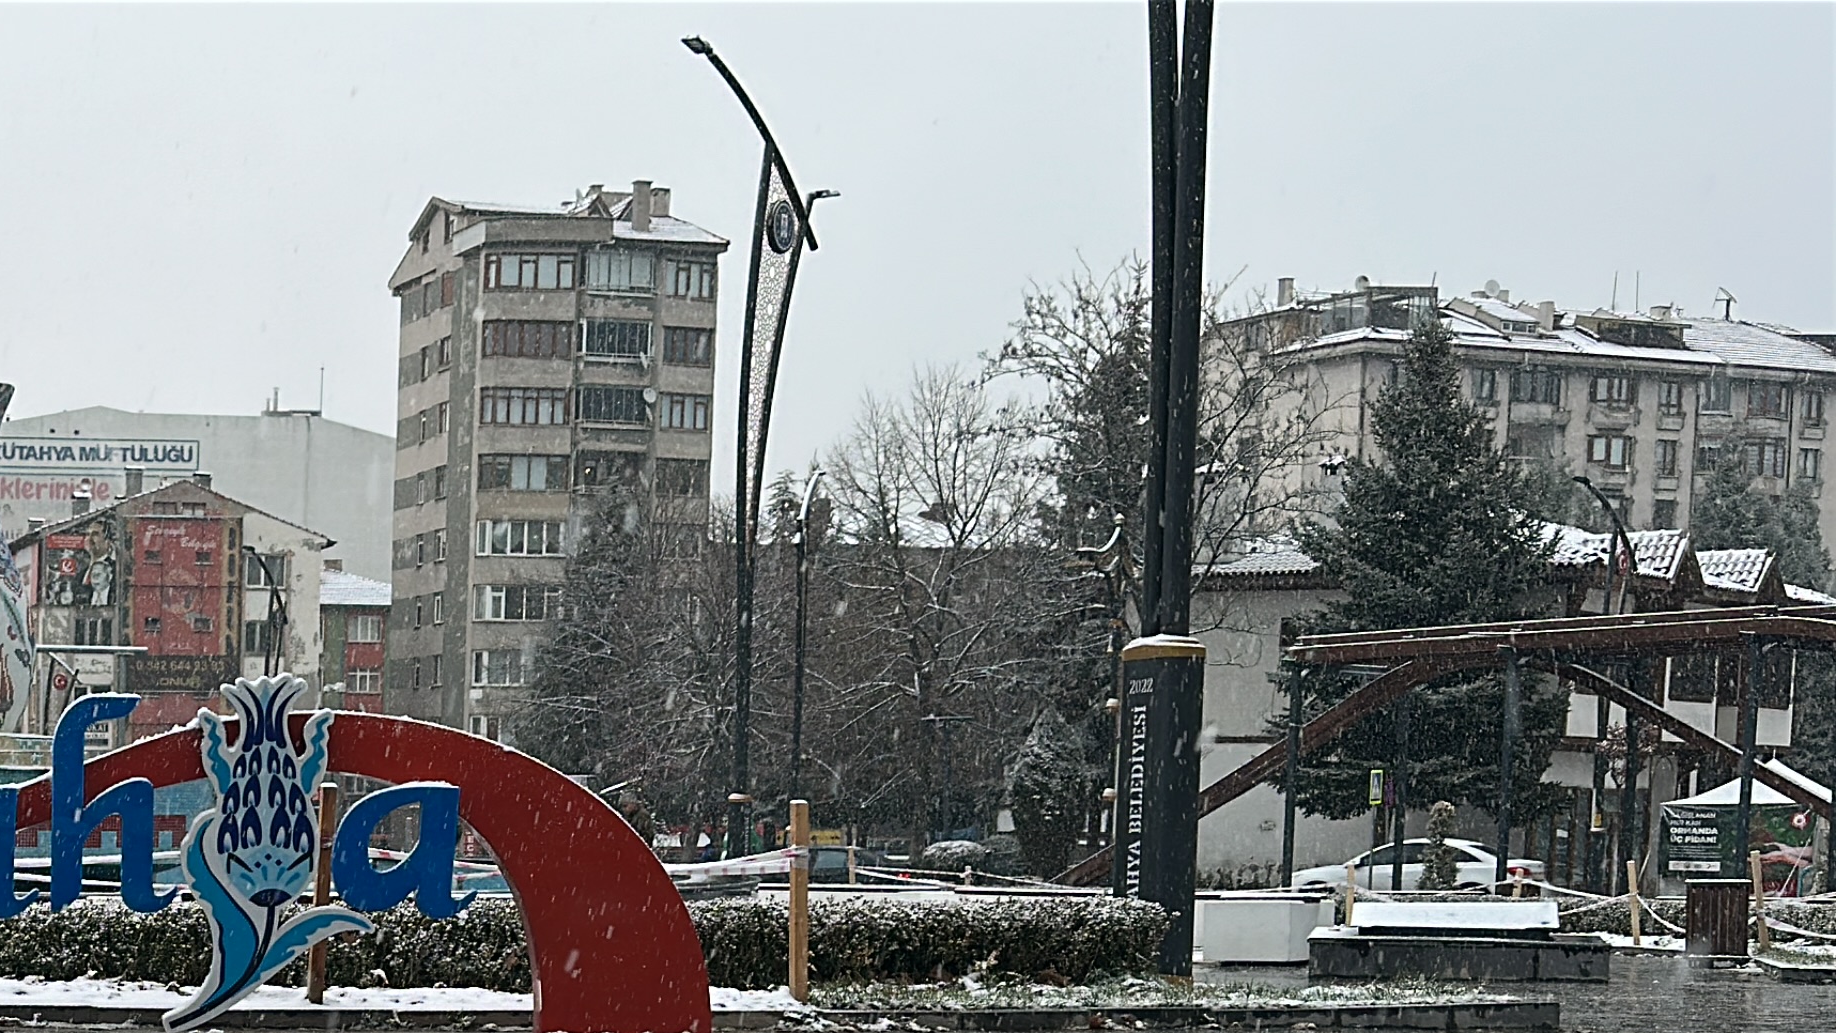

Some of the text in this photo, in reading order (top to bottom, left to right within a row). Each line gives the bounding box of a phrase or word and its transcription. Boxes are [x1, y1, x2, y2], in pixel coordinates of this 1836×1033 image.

[1129, 677, 1154, 695] 2022
[1126, 705, 1147, 901] AHYA BELEDİYESİ
[1670, 827, 1718, 835] ORMANDA
